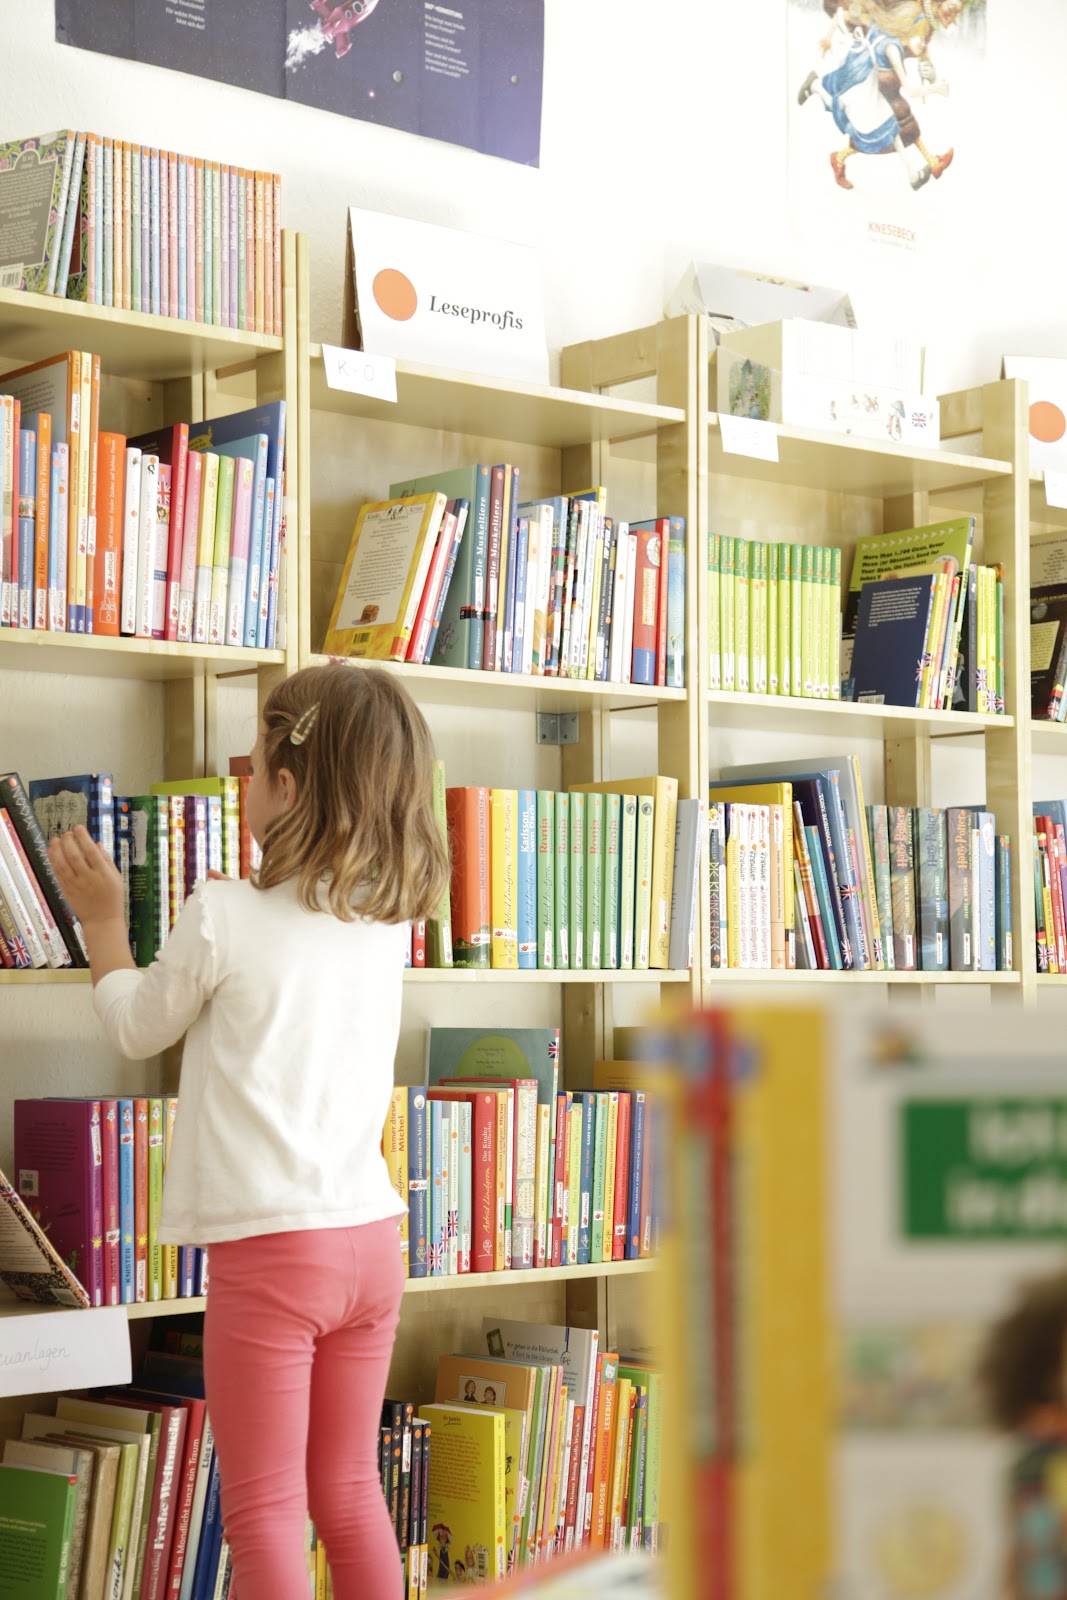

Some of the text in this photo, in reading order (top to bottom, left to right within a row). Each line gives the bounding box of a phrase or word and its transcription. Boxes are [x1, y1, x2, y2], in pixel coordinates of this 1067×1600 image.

[868, 221, 917, 241] KNESEBECK
[429, 295, 524, 331] Leseprofis
[40, 444, 48, 475] Freunde
[40, 478, 49, 498] gibt's
[38, 500, 47, 522] Glück
[476, 497, 486, 555] Muskeltiere
[489, 499, 500, 577] Die Muskeltiere
[10, 785, 37, 830] MOON
[818, 793, 826, 812] TONY
[520, 811, 529, 852] Karlsson
[589, 819, 599, 855] Ronja
[608, 819, 617, 855] Ronja
[821, 813, 832, 847] ROBINSON
[894, 813, 906, 841] Potter
[955, 815, 966, 843] Potter
[896, 841, 907, 868] Harry
[957, 844, 968, 869] Harry
[503, 862, 513, 901] Lindgren
[539, 818, 553, 930] Astrid Lindgren Ronja
[709, 862, 720, 877] DIE
[709, 882, 720, 917] KLEINE
[504, 902, 512, 928] Astrid
[709, 919, 720, 950] HEXE
[396, 1165, 404, 1198] ndgren
[482, 1165, 492, 1203] Lindgren
[478, 1205, 490, 1233] Astrid
[514, 1343, 525, 1351] gehen
[538, 1344, 559, 1354] Bibliothek
[539, 1353, 553, 1363] Library
[604, 1390, 613, 1430] LESEBUCH
[189, 1439, 199, 1465] Traum
[202, 1447, 212, 1468] Lies
[570, 1461, 578, 1481] König
[184, 1483, 193, 1507] tanzt
[599, 1482, 607, 1516] GROSSE
[153, 1502, 170, 1550] Frohe
[177, 1509, 190, 1554] Mondlicht
[597, 1517, 605, 1535] DAS
[60, 1542, 69, 1567] Olchis
[175, 1556, 183, 1568] Im
